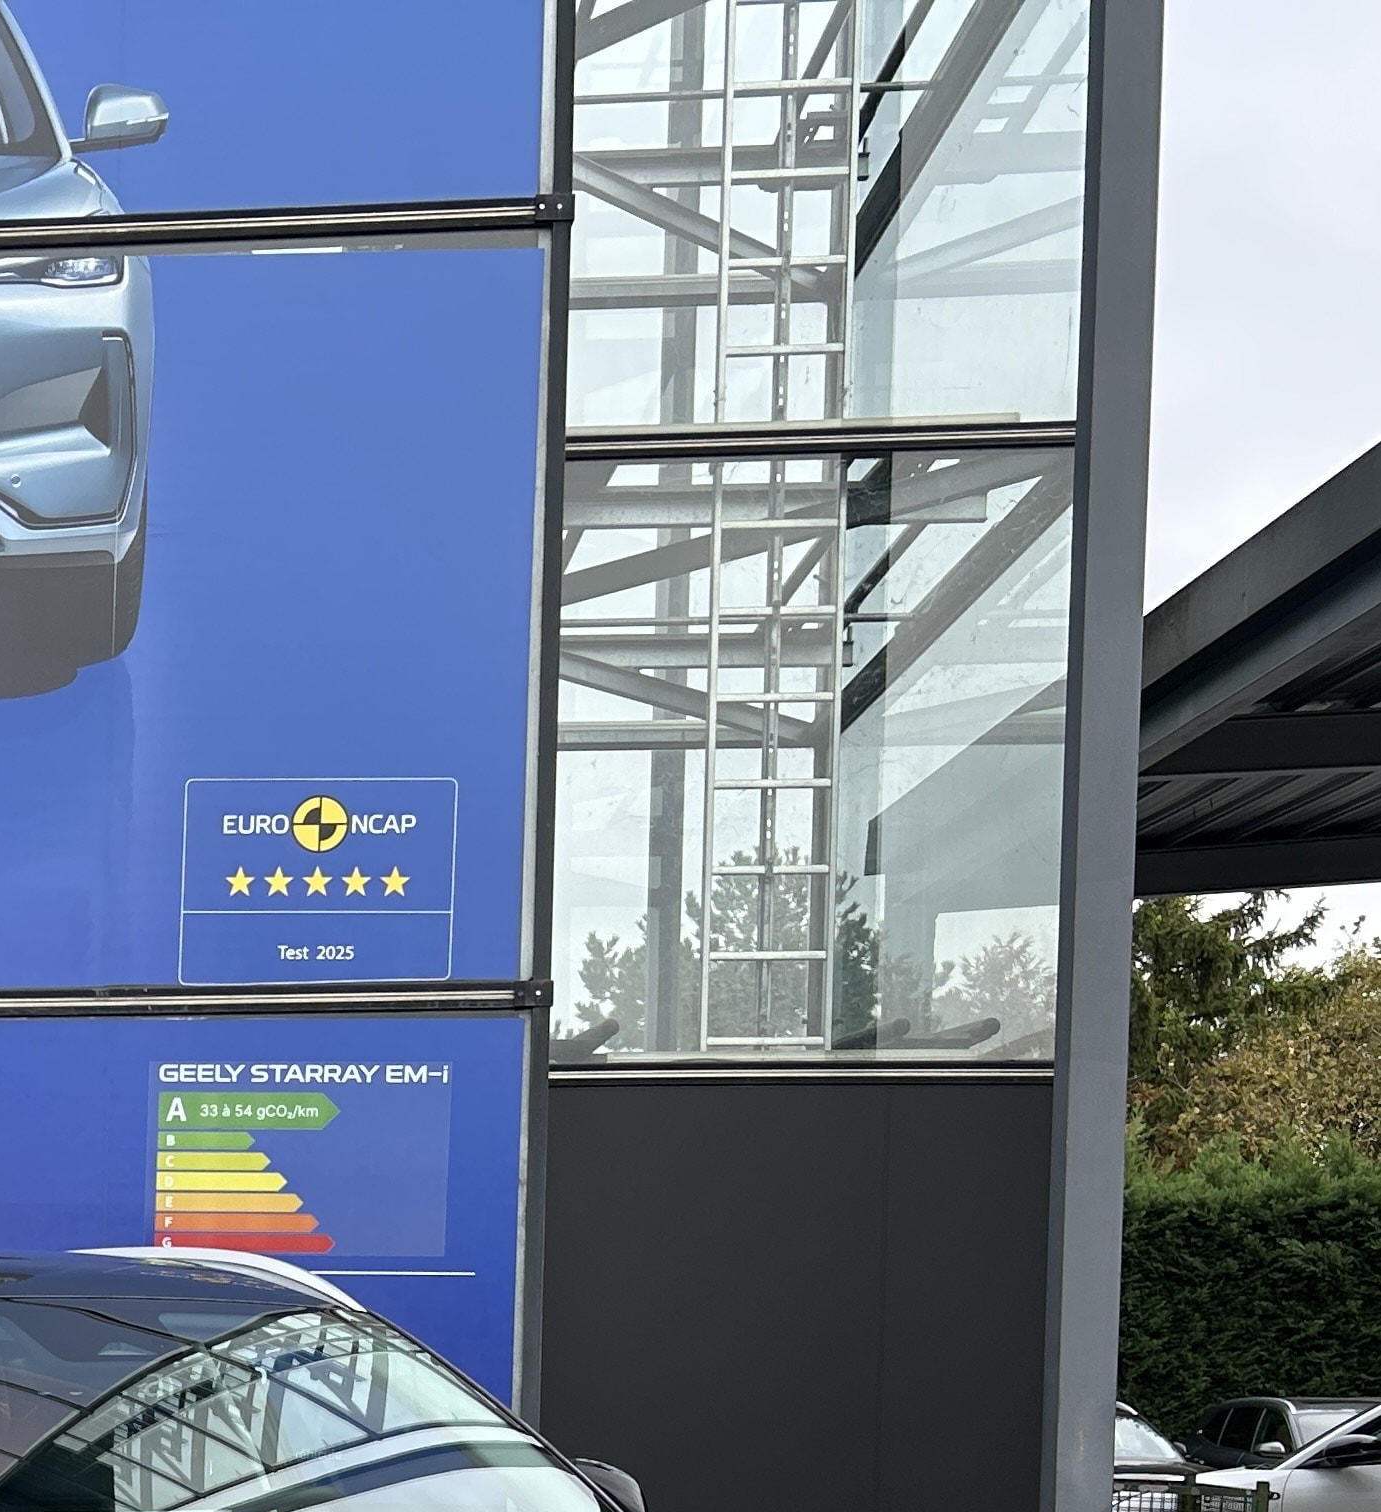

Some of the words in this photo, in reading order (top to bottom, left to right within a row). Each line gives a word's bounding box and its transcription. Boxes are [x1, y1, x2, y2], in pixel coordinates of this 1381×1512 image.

[223, 814, 289, 835] EURO
[351, 814, 417, 834] NCAP
[277, 945, 309, 960] Test
[316, 945, 355, 961] 2025
[158, 1063, 246, 1083] GEELY
[250, 1063, 381, 1083] STARRAY
[385, 1063, 450, 1084] EM-i
[165, 1097, 187, 1122] A
[200, 1103, 219, 1118] 33
[221, 1102, 231, 1118] à
[234, 1103, 253, 1118] 54
